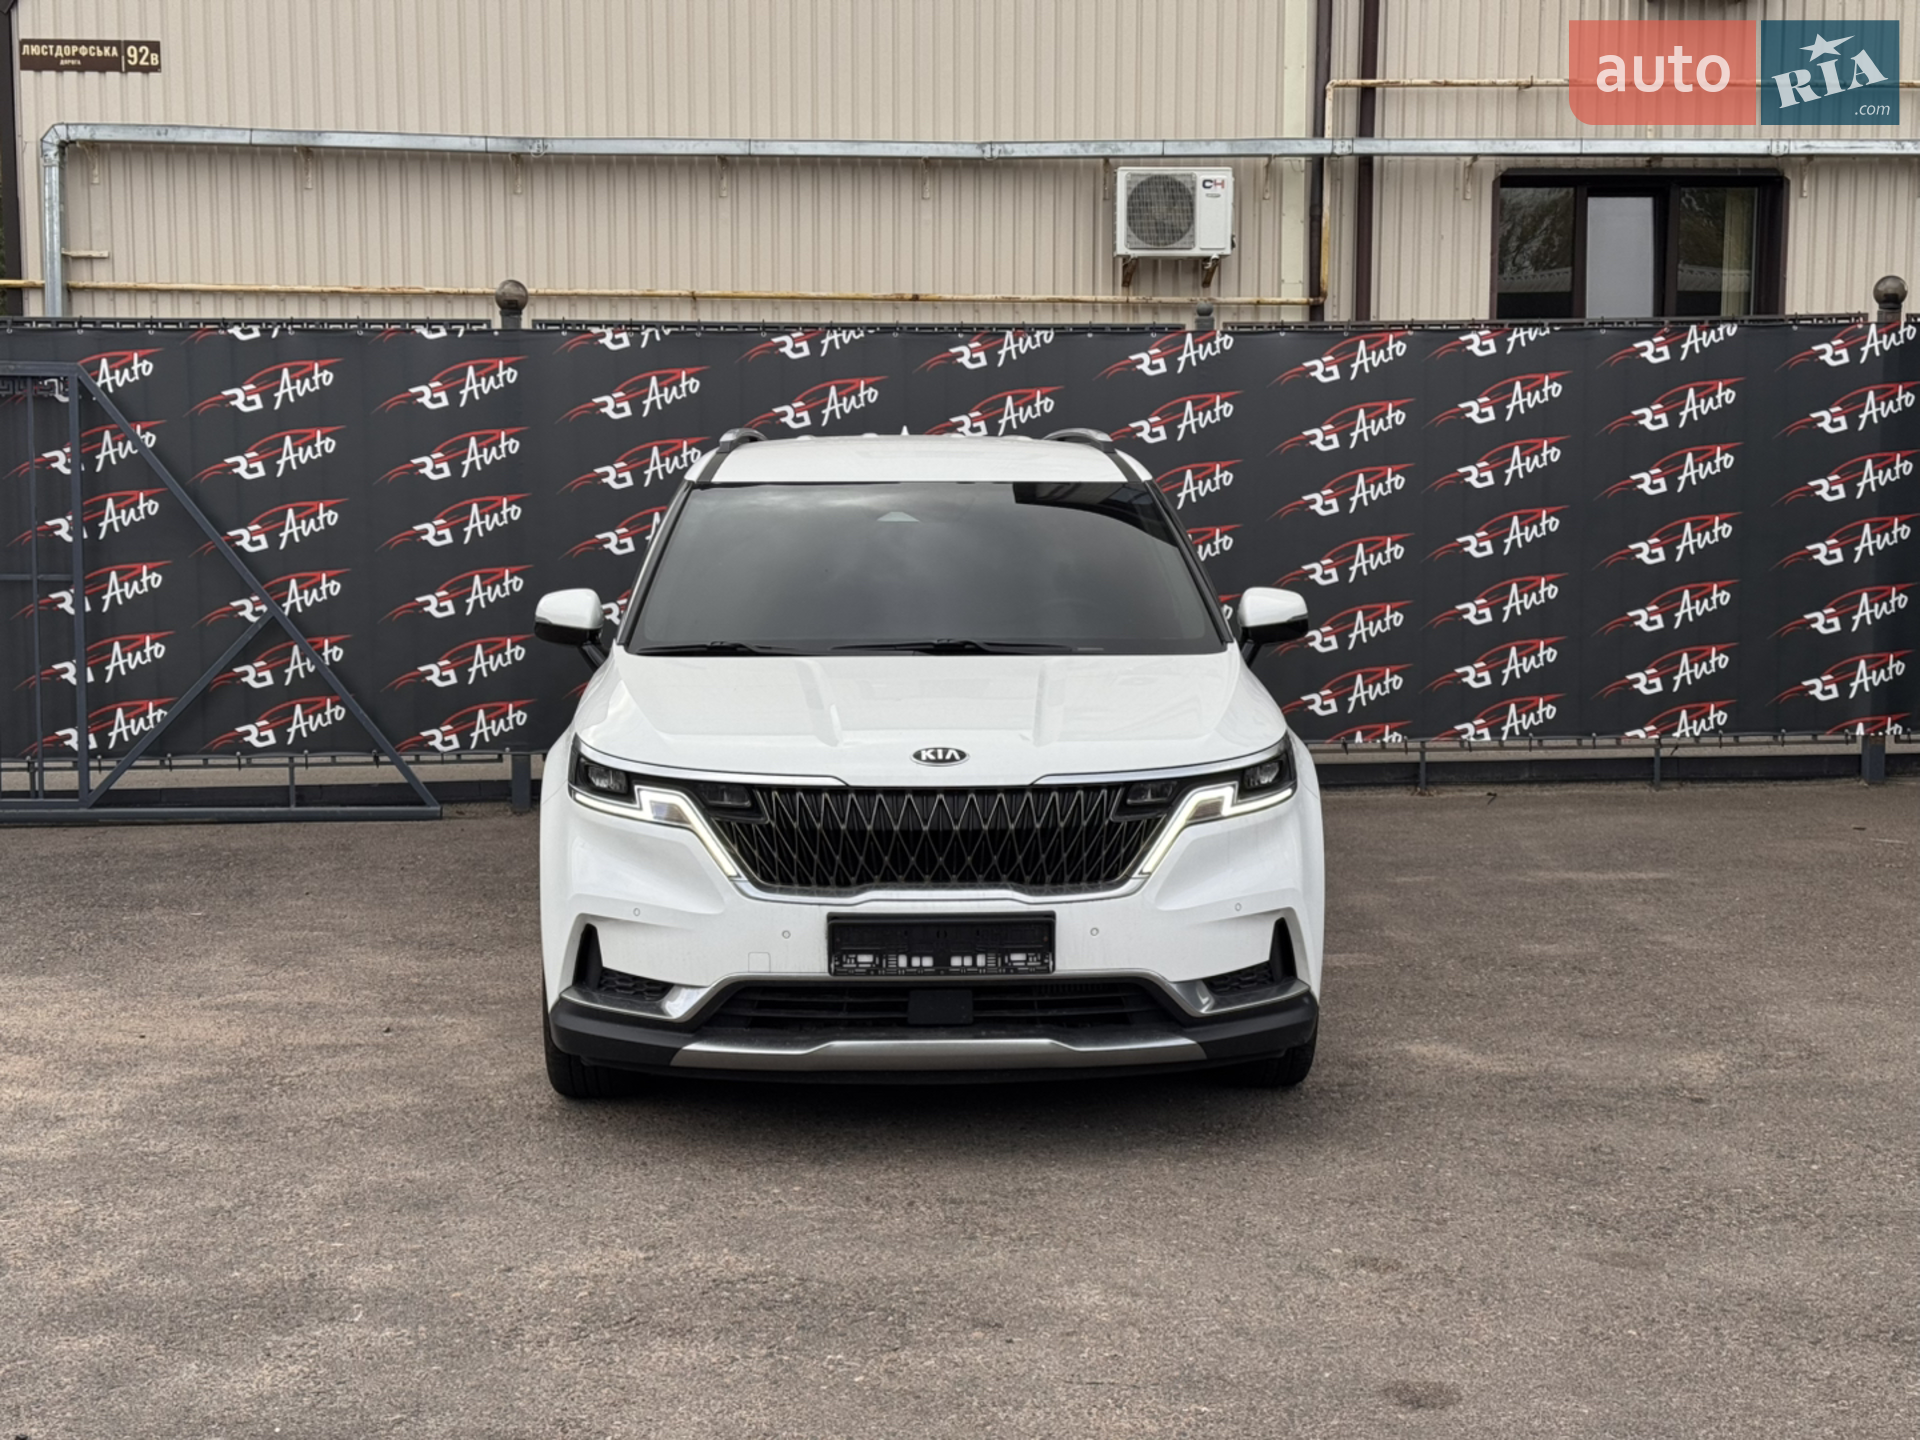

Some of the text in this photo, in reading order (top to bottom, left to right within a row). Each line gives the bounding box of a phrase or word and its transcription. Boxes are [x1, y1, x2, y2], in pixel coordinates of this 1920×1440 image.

[22, 44, 118, 58] ЛЮСТДОРФСЬКА
[771, 331, 811, 359] RG
[949, 341, 988, 369] RG
[1128, 330, 1234, 376] RG Auto
[1301, 334, 1407, 383] RG Auto
[1459, 330, 1497, 357] RG
[1633, 336, 1671, 363] RG
[1811, 322, 1917, 367] RG Auto
[95, 351, 154, 394] Auto
[221, 362, 334, 412] RG Auto
[408, 360, 518, 410] RG Auto
[592, 370, 700, 419] RG Auto
[772, 379, 879, 429] RG Auto
[998, 389, 1055, 436] Auto
[1128, 395, 1234, 443] RG Auto
[1458, 375, 1562, 424] RG Auto
[1631, 382, 1736, 431] RG Auto
[1809, 384, 1915, 434] RG Auto
[1302, 402, 1406, 452] RG Auto
[224, 429, 336, 479] RG Auto
[410, 430, 520, 480] RG Auto
[593, 440, 701, 490] RG Auto
[1457, 439, 1561, 489] RG Auto
[1630, 446, 1735, 495] RG Auto
[1807, 453, 1913, 502] RG Auto
[1177, 463, 1234, 510] Auto
[1301, 467, 1405, 516] RG Auto
[98, 491, 159, 540] Auto
[227, 502, 339, 552] RG Auto
[412, 497, 522, 547] RG Auto
[1456, 509, 1560, 558] RG Auto
[595, 527, 636, 555] RG
[1191, 528, 1233, 561] uto
[1301, 537, 1405, 586] RG Auto
[1628, 516, 1733, 565] RG Auto
[1805, 517, 1911, 565] RG Auto
[101, 565, 163, 612] Auto
[282, 572, 341, 616] Auto
[415, 569, 524, 618] RG Auto
[1455, 577, 1559, 625] RG Auto
[1627, 584, 1731, 632] RG Auto
[1803, 586, 1908, 635] RG Auto
[1348, 604, 1404, 650] Auto
[105, 635, 166, 683] Auto
[233, 661, 274, 688] RG
[417, 637, 526, 688] RG Auto
[1454, 640, 1558, 688] RG Auto
[1626, 647, 1729, 695] RG Auto
[1801, 653, 1906, 701] RG Auto
[1301, 667, 1403, 716] RG Auto
[235, 698, 346, 748] RG Auto
[419, 703, 528, 751] RG Auto
[1501, 697, 1557, 741] Auto
[920, 748, 961, 761] KIA
